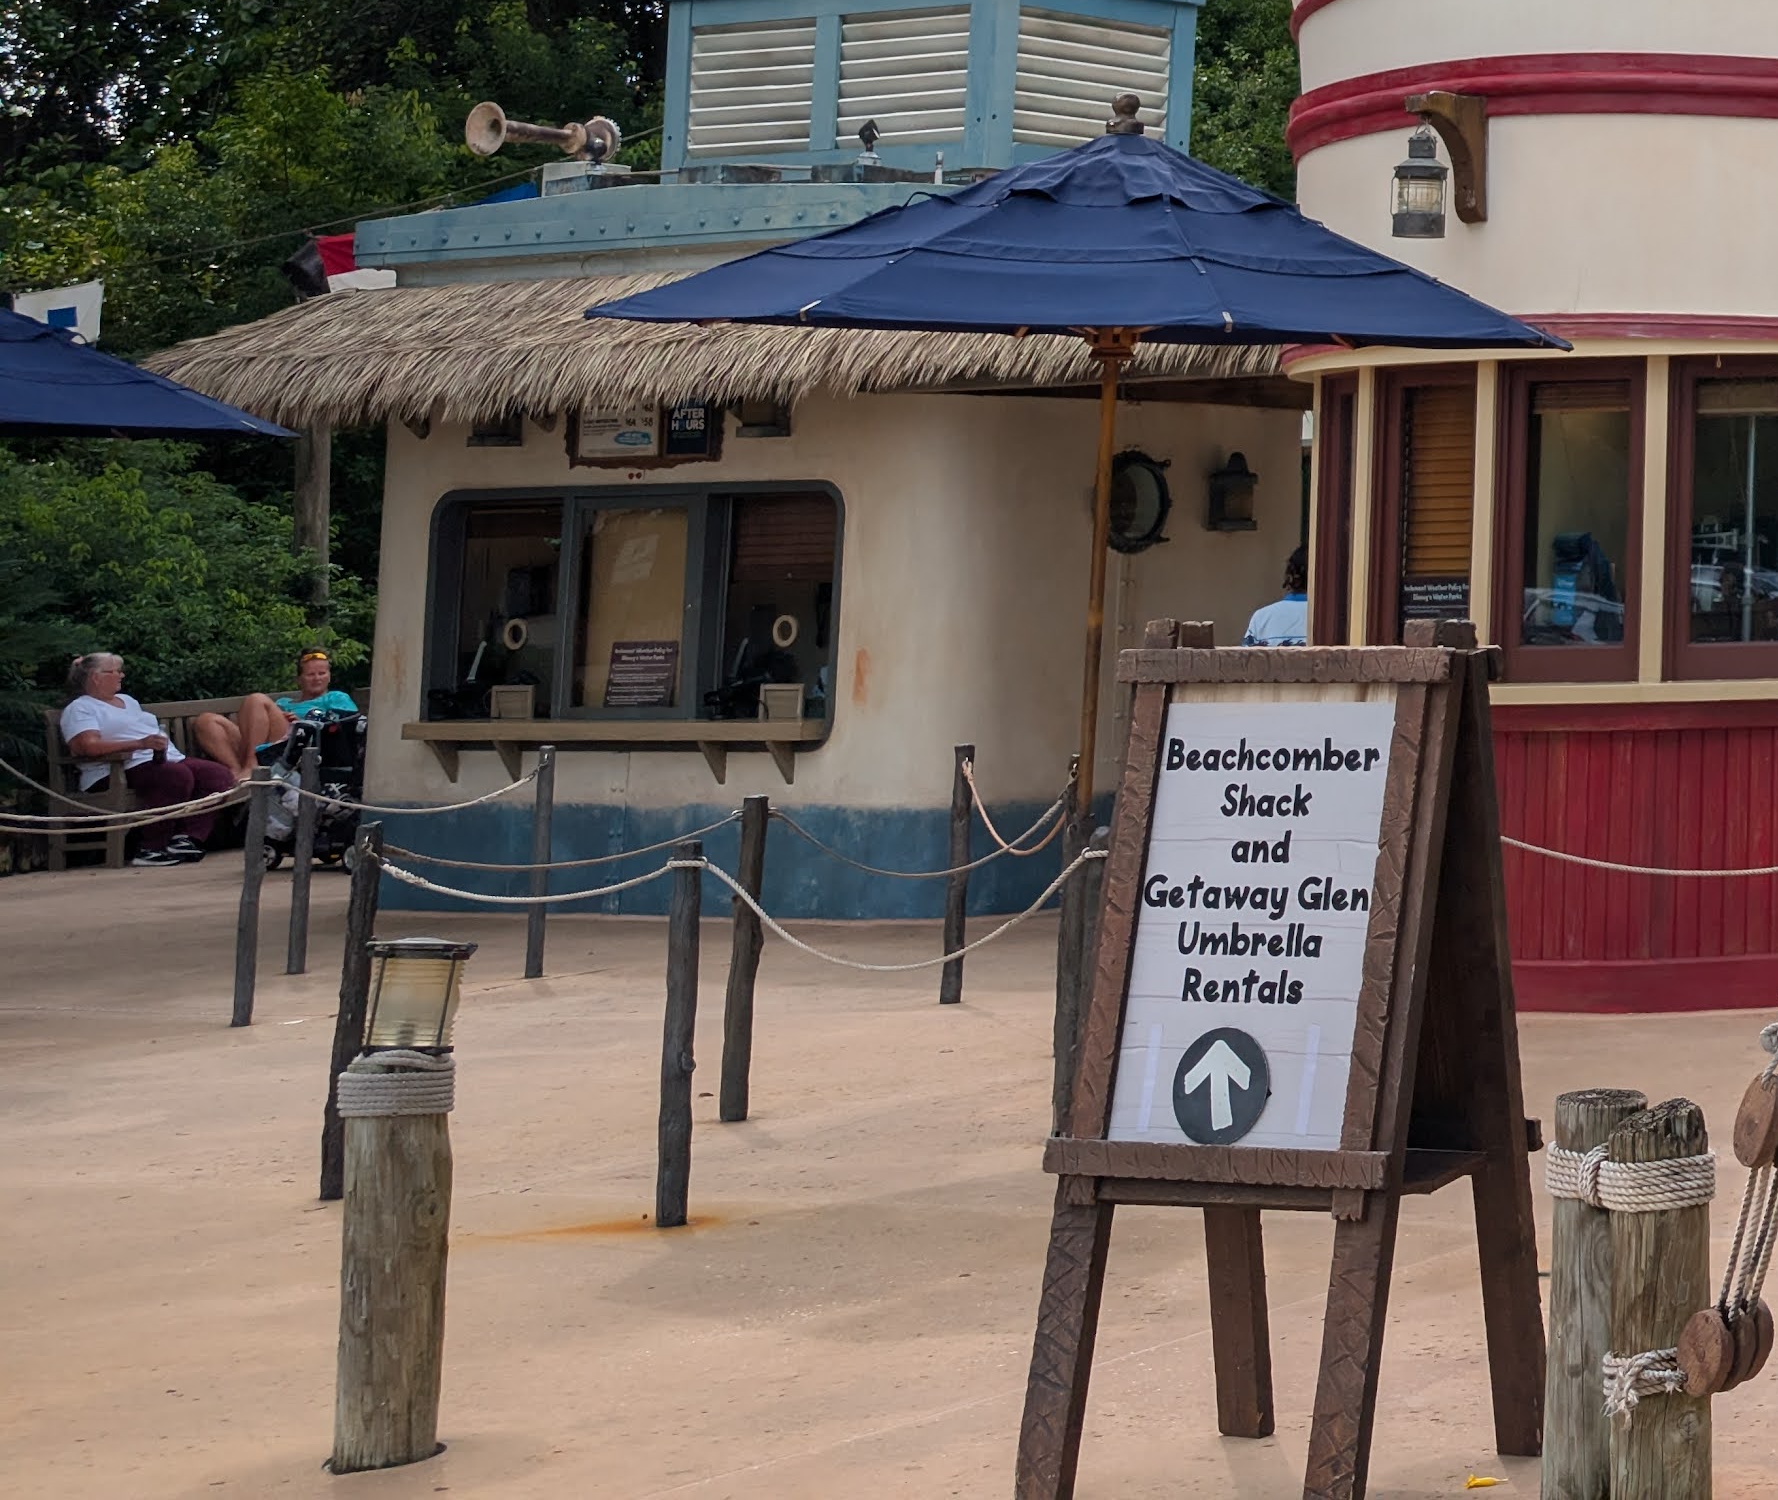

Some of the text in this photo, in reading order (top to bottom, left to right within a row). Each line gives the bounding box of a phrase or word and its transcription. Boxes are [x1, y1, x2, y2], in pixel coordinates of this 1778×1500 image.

[671, 419, 705, 431] HOURS
[672, 408, 705, 419] AFTER
[1165, 738, 1381, 772] Beachcomber
[1220, 783, 1313, 818] Shack
[1231, 830, 1291, 864] and
[1144, 874, 1370, 921] Getaway Glen
[1177, 921, 1323, 959] Umbrella
[1181, 968, 1304, 1006] Rentals
